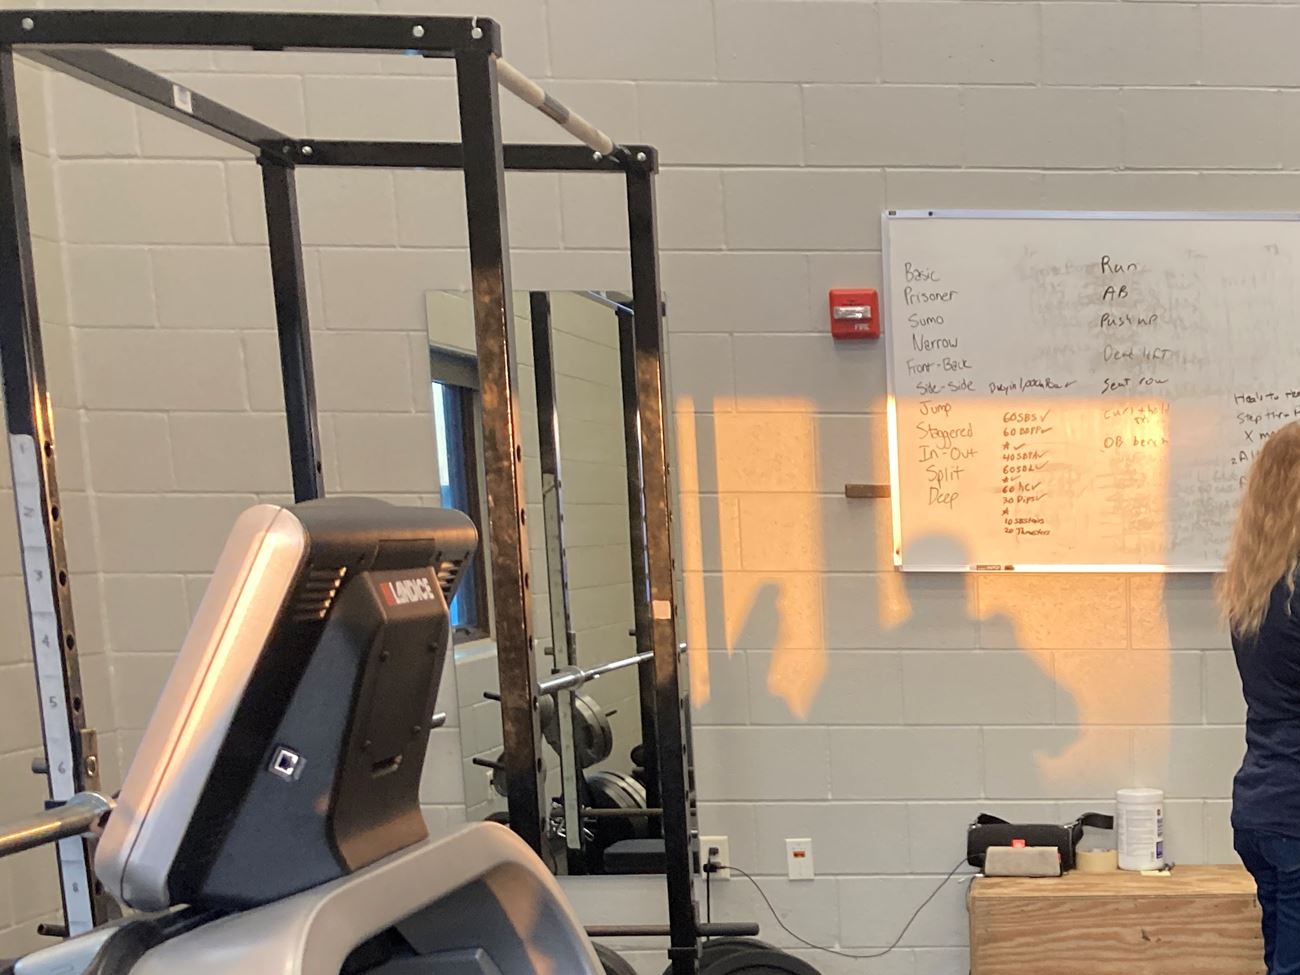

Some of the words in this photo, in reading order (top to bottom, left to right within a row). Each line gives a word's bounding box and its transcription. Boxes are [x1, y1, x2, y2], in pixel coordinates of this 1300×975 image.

[905, 262, 941, 282] Basic
[1101, 254, 1139, 274] Run
[904, 286, 960, 306] Prisoner
[1102, 285, 1129, 301] AB
[908, 313, 944, 328] Sumo
[919, 400, 952, 416] Jump
[916, 422, 974, 450] Staggered
[918, 447, 978, 463] In-Out
[926, 466, 966, 488] Split
[928, 487, 960, 510] Deep
